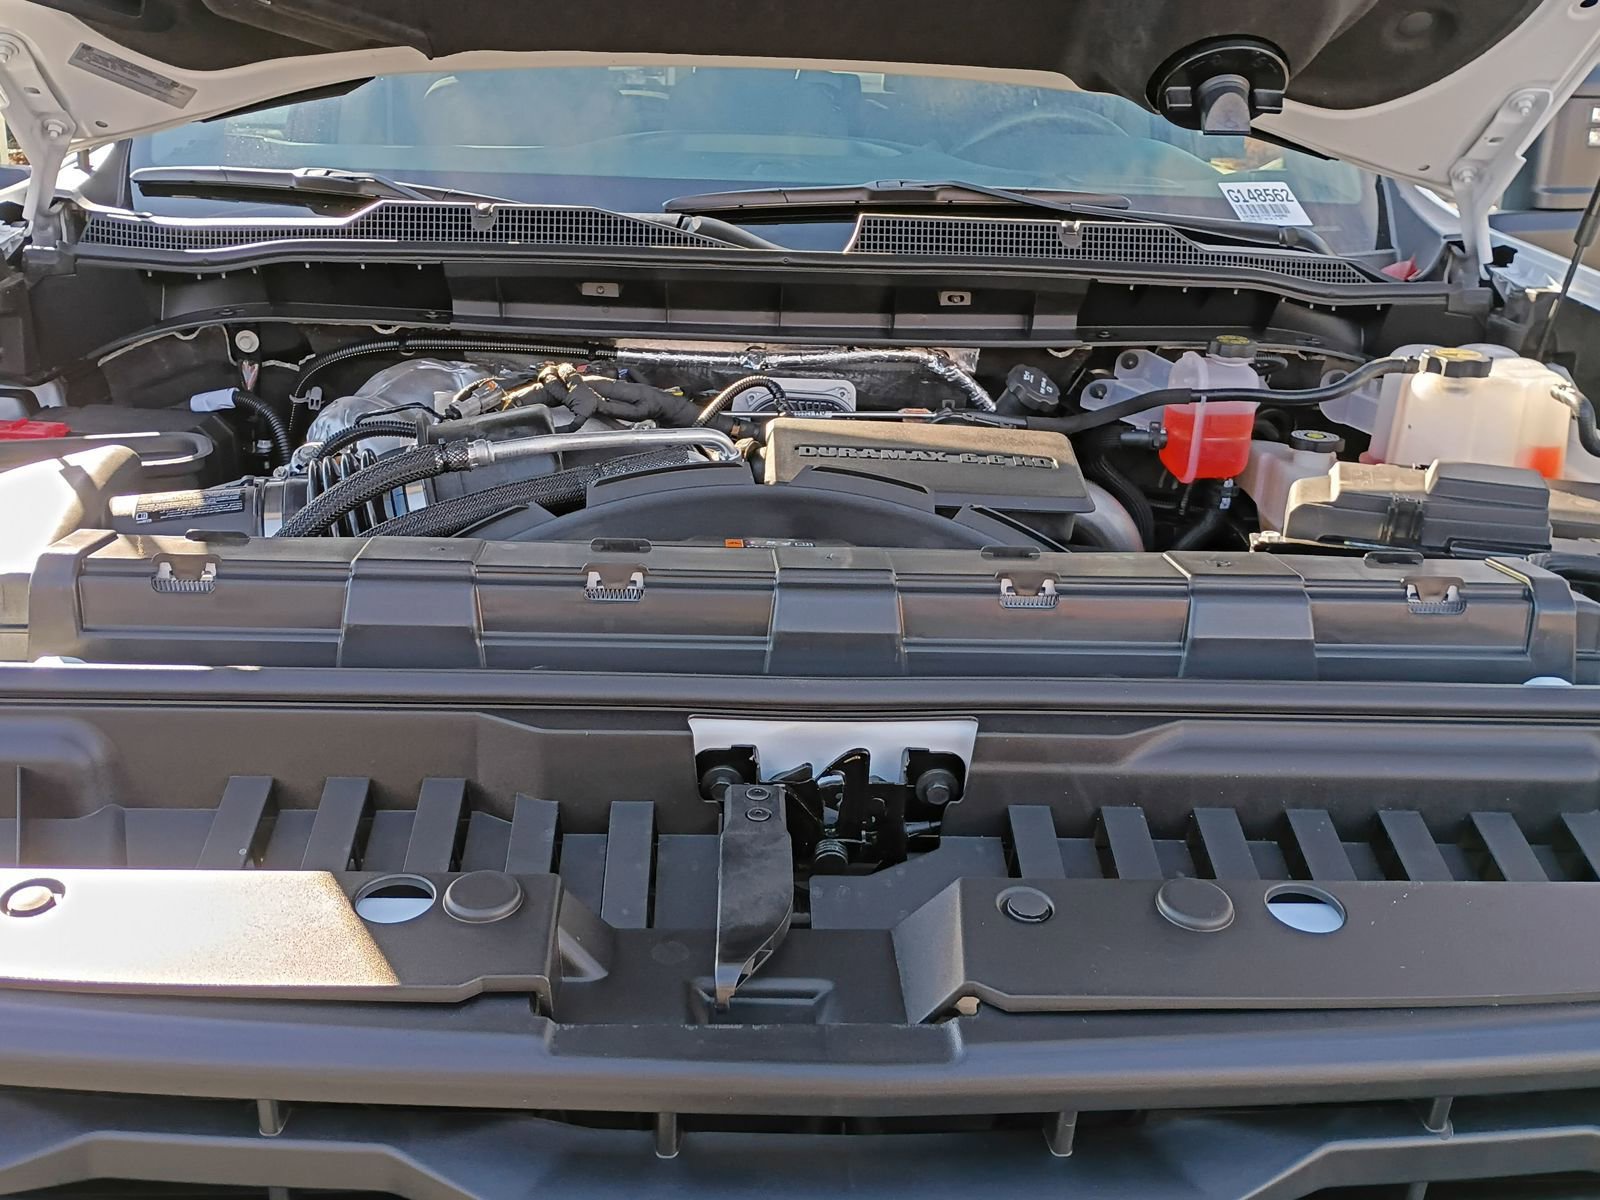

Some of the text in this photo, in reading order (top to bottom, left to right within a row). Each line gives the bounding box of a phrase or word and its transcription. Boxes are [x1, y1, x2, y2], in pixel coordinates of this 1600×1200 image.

[1226, 188, 1294, 203] G148562
[797, 446, 949, 463] DURAMAX
[959, 453, 1006, 465] 6.6
